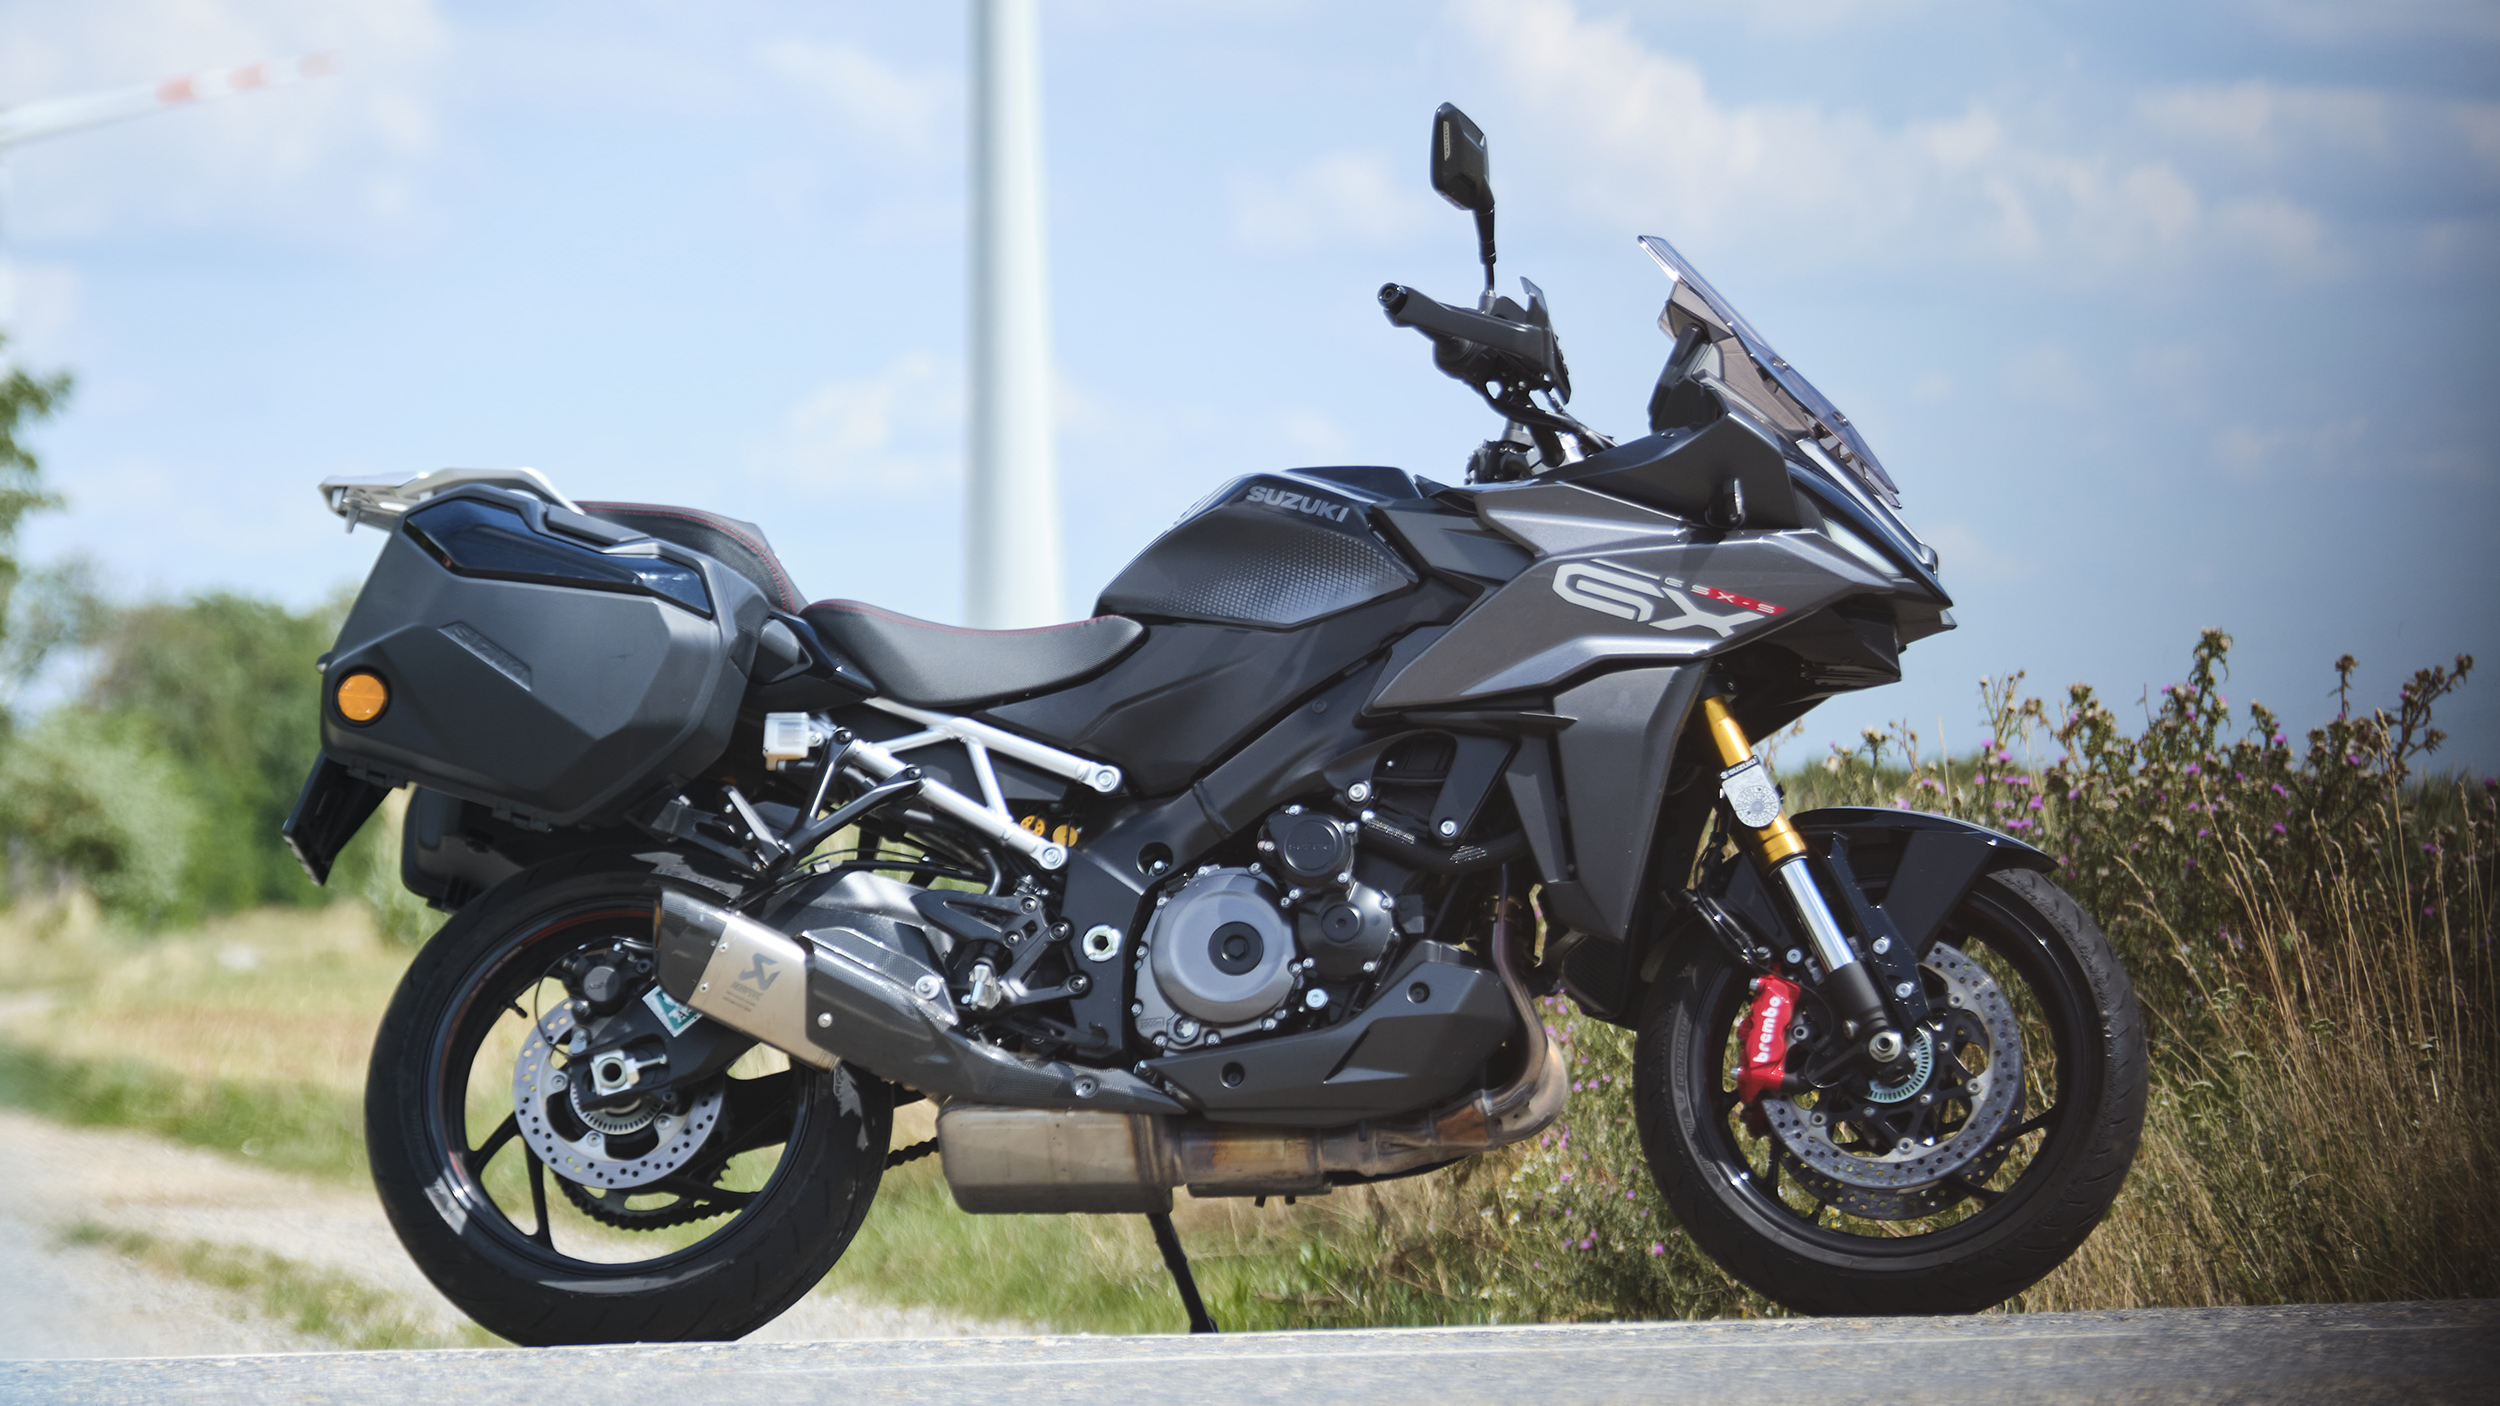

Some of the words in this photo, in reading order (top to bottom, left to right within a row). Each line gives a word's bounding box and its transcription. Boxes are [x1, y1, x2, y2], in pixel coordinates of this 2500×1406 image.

[1246, 485, 1350, 523] SUZUKI
[1728, 758, 1757, 776] SUZUKI
[1752, 996, 1781, 1063] brembo
